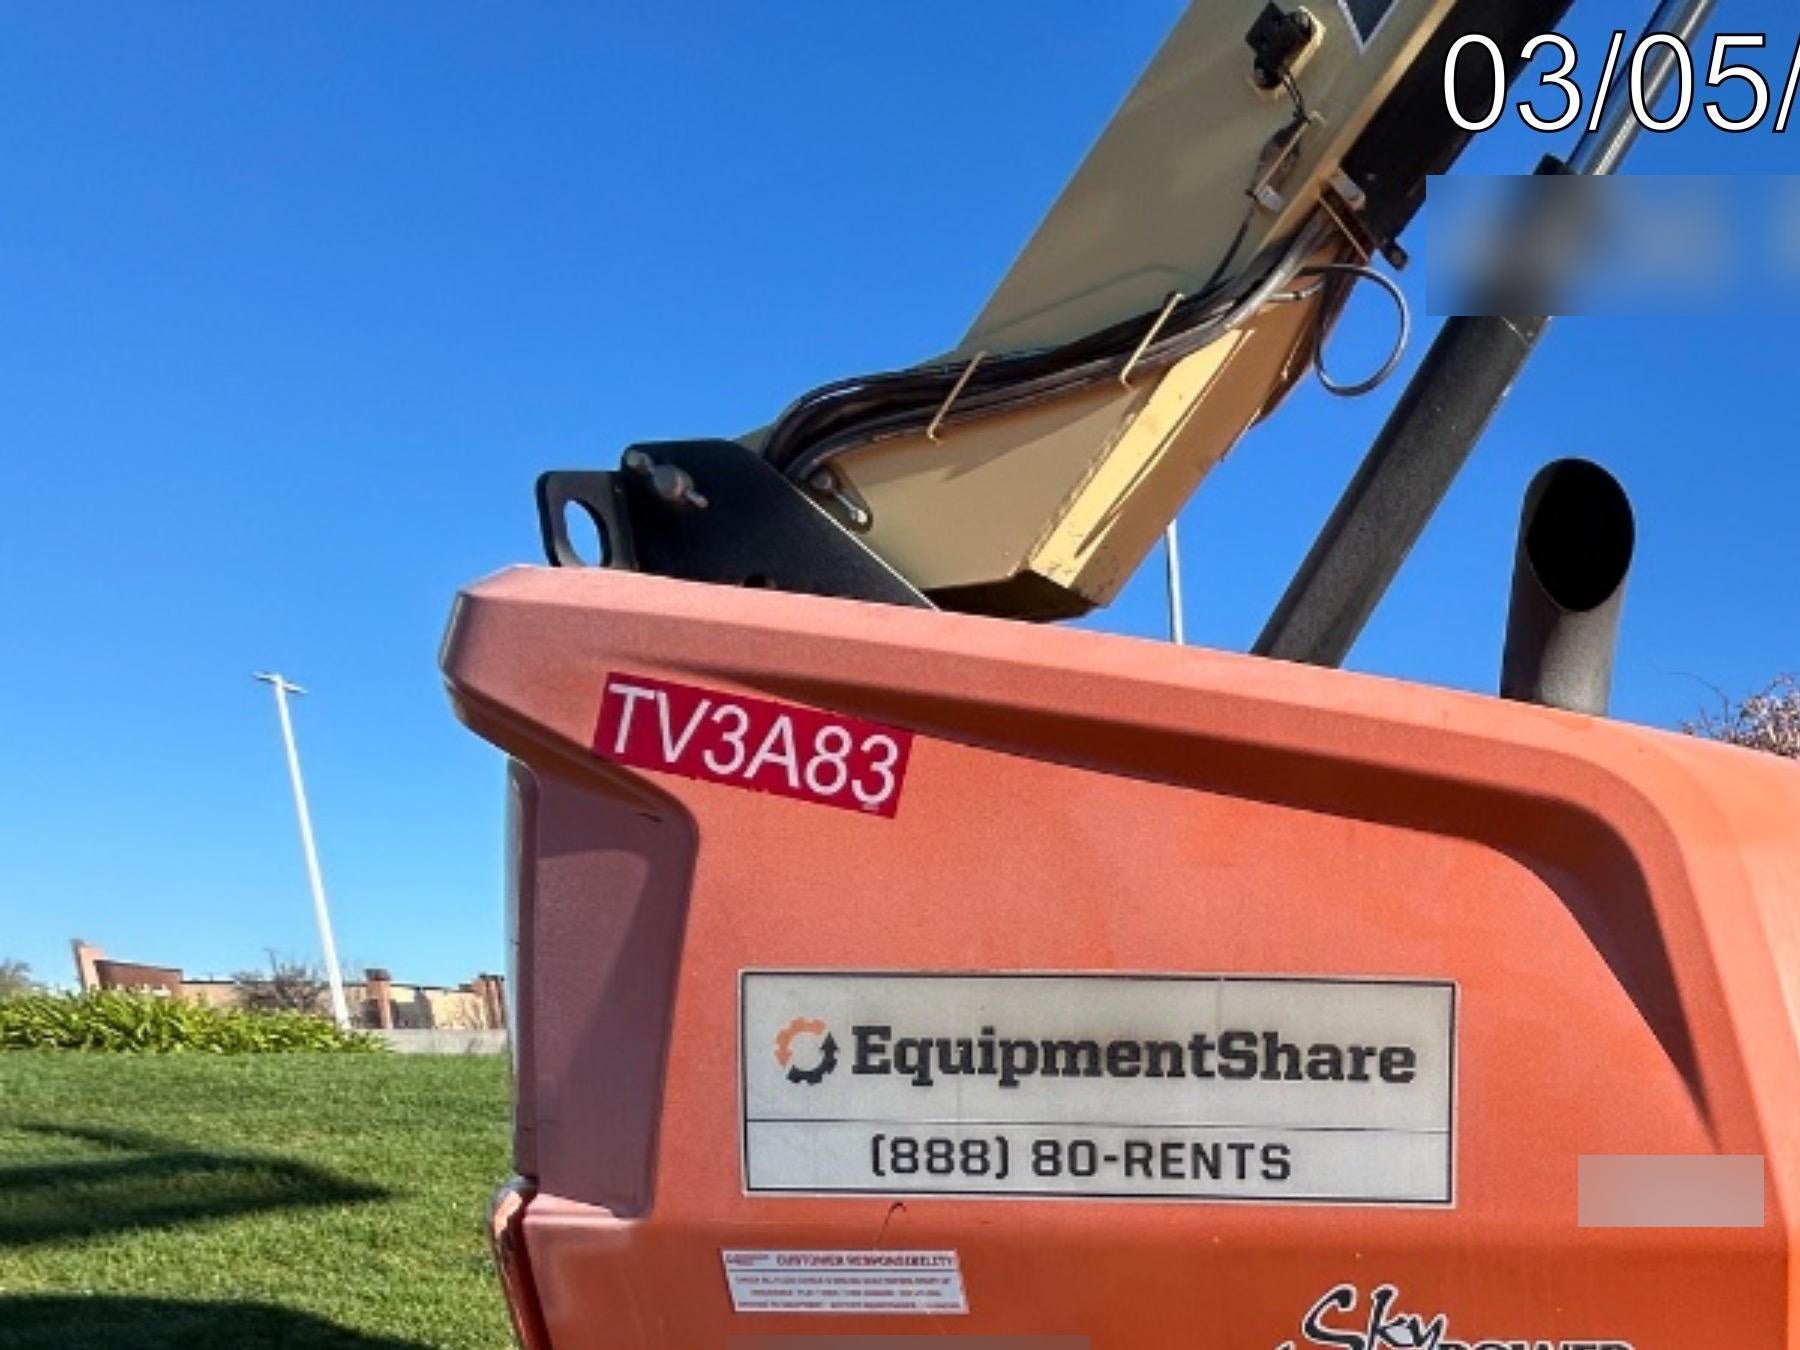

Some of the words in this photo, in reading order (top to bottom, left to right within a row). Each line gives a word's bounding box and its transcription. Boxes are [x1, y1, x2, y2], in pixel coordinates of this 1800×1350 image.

[607, 683, 900, 805] TV3A83
[851, 1024, 1417, 1088] EquipmentShare
[871, 1134, 1010, 1181] (888)
[1032, 1137, 1292, 1183] 80-RENTS
